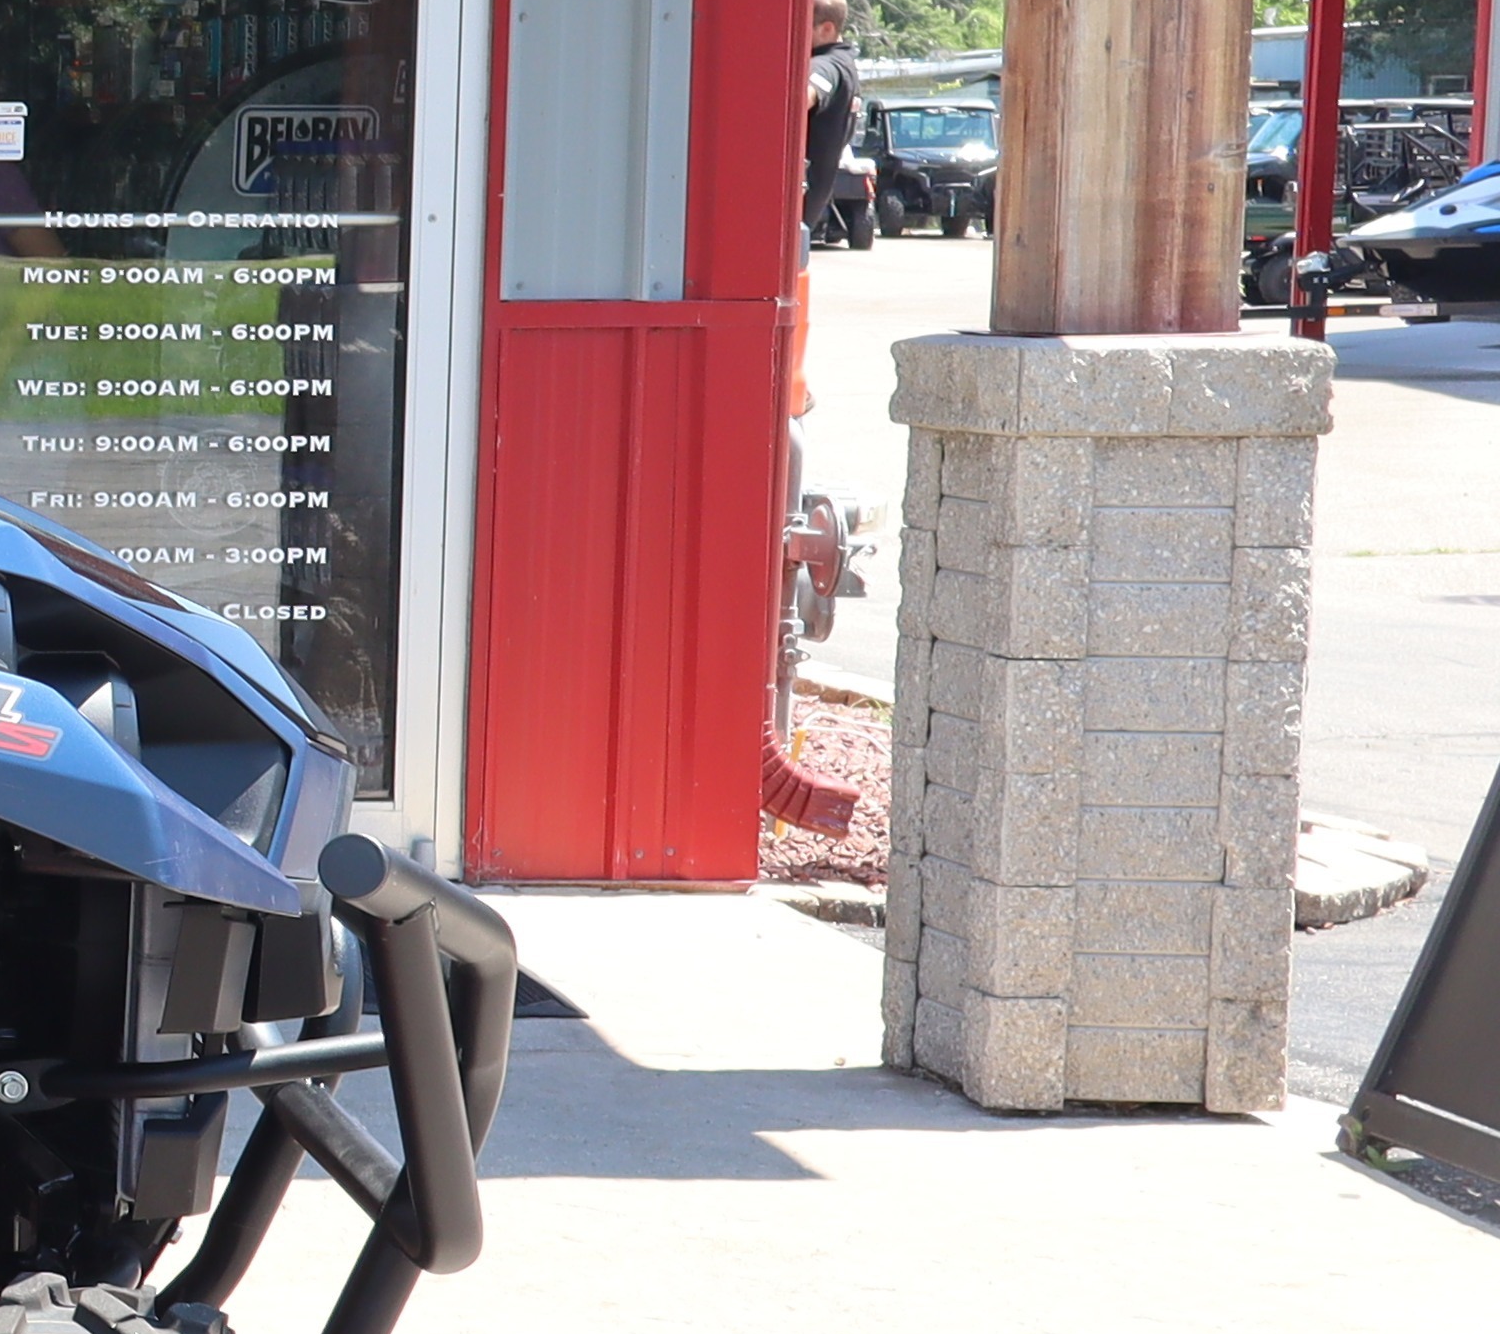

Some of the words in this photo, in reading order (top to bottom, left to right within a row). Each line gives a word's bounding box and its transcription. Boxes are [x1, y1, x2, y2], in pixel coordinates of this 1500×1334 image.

[233, 267, 336, 285] 6:00PM
[98, 323, 202, 341] 9:00AM
[231, 323, 334, 341] 6:00PM
[96, 379, 200, 396] 9:00AM
[229, 379, 333, 396] 6:00PM
[95, 435, 198, 452] 9:00AM
[228, 435, 330, 452] 6:00PM
[93, 491, 197, 508] 9:00AM
[226, 491, 329, 508] 6:00PM
[225, 547, 327, 564] 3:00PM
